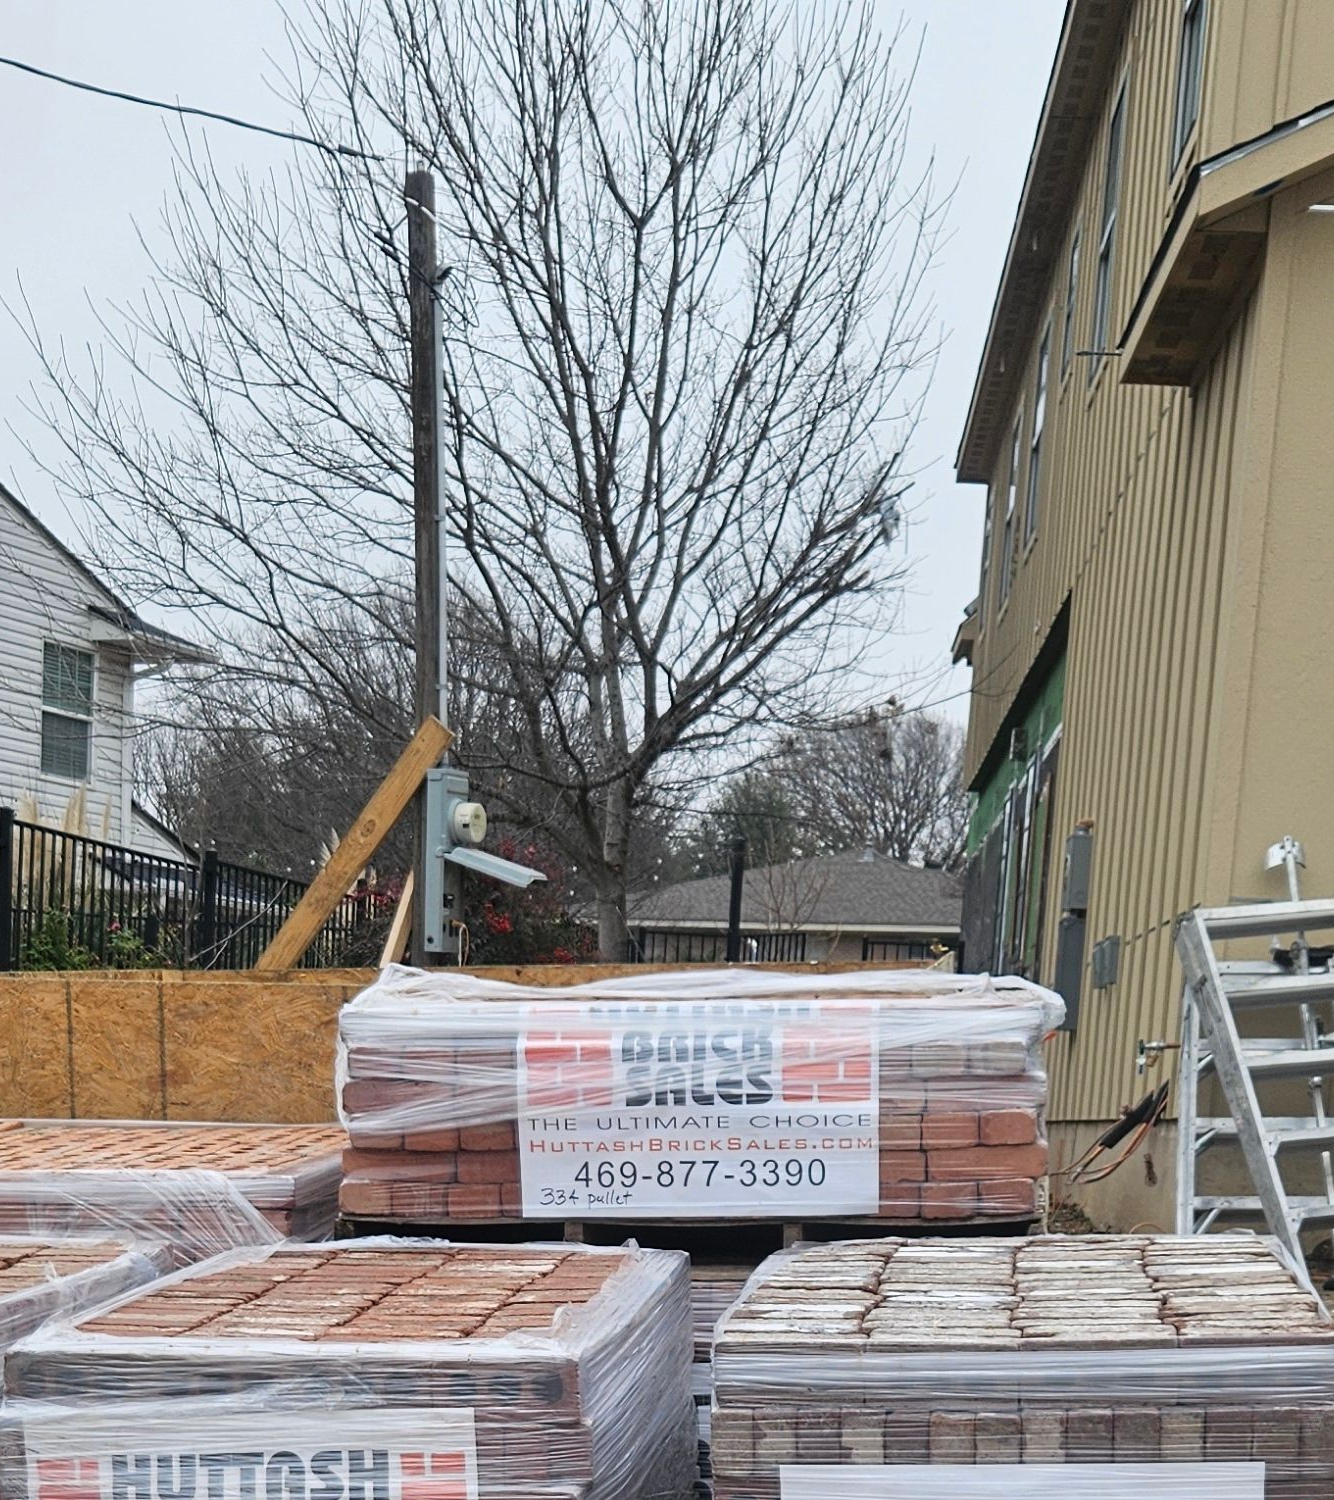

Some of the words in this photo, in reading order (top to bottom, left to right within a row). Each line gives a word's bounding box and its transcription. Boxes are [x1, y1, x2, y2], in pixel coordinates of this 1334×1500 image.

[622, 1029, 773, 1062] BRICK
[625, 1064, 774, 1107] SALES
[527, 1118, 577, 1131] THE
[597, 1116, 730, 1129] ULTIMATE
[750, 1114, 871, 1128] CHOICE
[530, 1137, 872, 1153] HUTTASHBRICKSALES.COM
[575, 1159, 826, 1188] 469-877-3390
